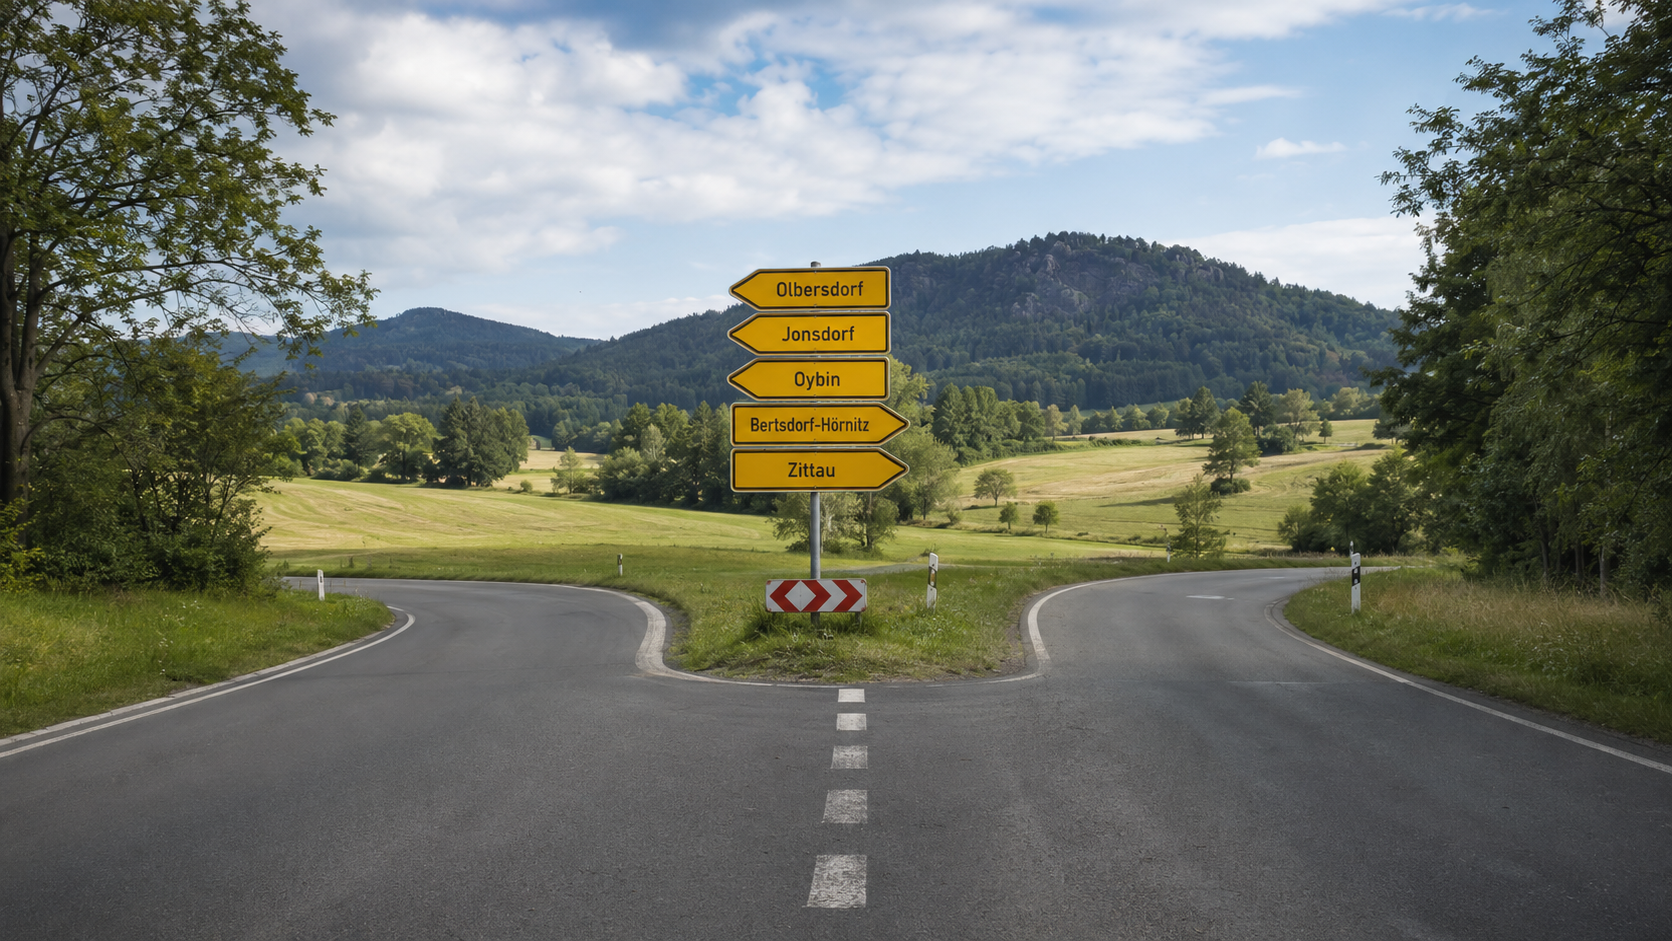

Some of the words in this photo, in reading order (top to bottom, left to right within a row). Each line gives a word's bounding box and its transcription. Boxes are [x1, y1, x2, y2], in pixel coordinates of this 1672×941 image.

[776, 281, 864, 297] Olbersdorf
[782, 325, 855, 342] Jonsdorf
[794, 371, 841, 390] Oybin
[750, 416, 870, 432] Bertsdorf-Hörnitz
[788, 462, 835, 478] Zittau
